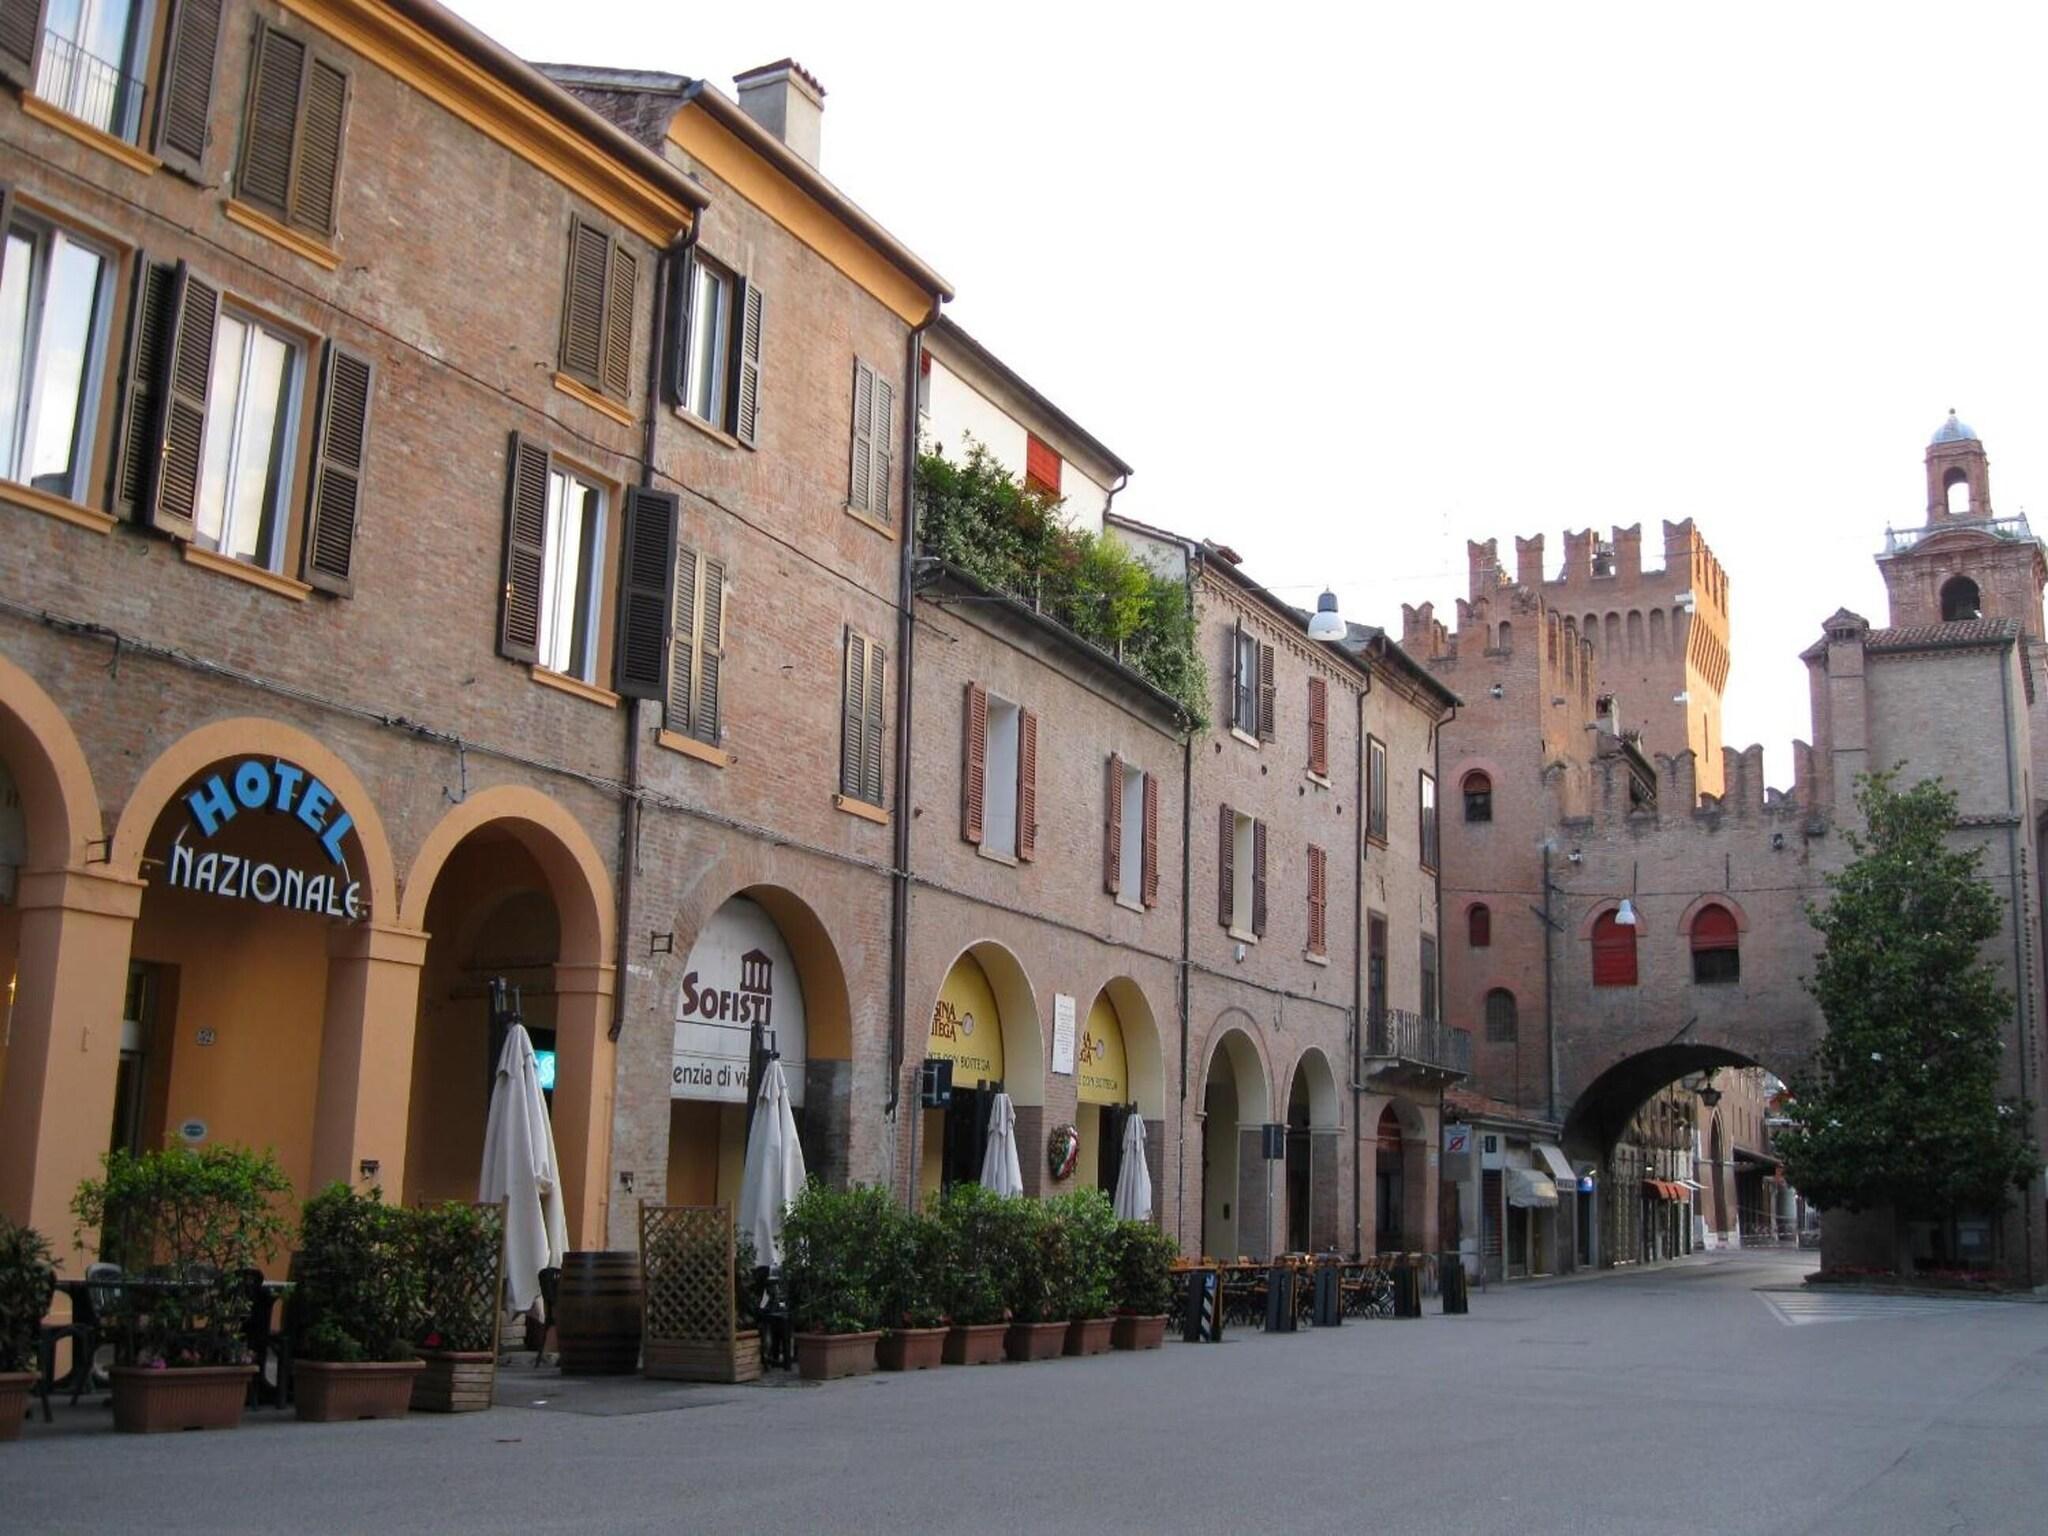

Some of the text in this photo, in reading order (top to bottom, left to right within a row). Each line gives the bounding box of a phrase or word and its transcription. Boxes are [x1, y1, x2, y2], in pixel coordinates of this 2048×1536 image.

[188, 760, 353, 865] HOTEL
[169, 844, 361, 919] NAZIONALE
[682, 971, 773, 1026] SOFISTI
[717, 1063, 731, 1087] di
